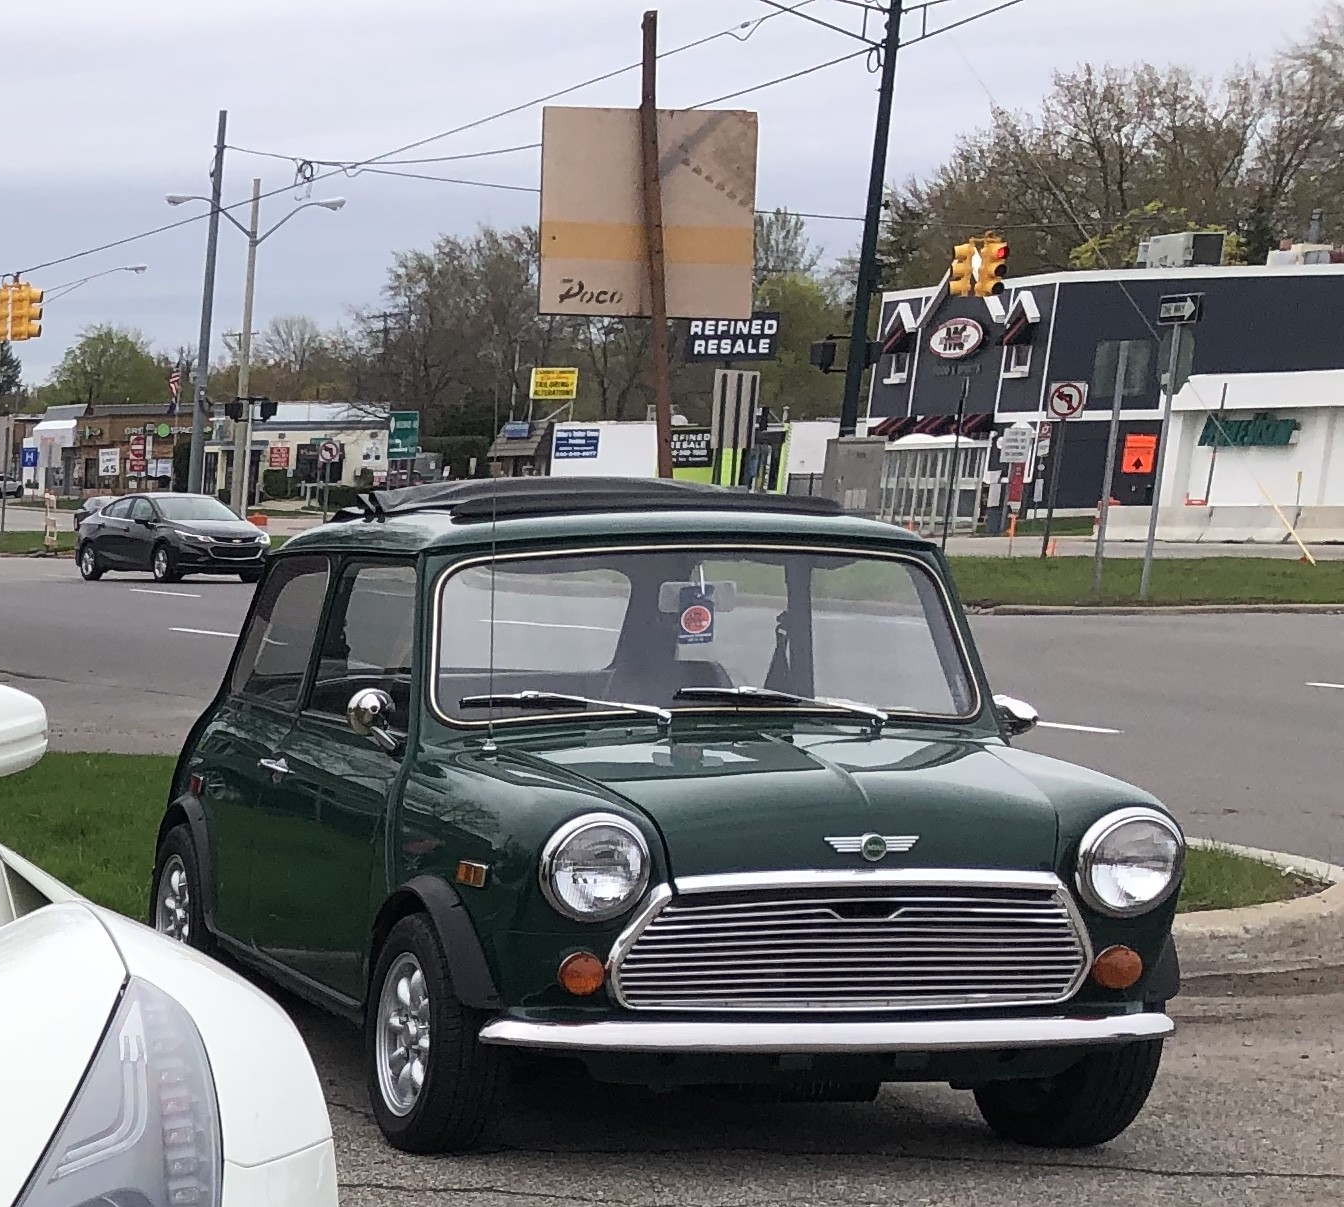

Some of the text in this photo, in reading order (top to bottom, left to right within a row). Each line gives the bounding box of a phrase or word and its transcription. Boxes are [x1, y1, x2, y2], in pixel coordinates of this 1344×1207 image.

[689, 320, 778, 335] REFINED
[693, 338, 770, 354] RESALE
[672, 433, 711, 441] EFINED
[102, 465, 117, 474] 45
